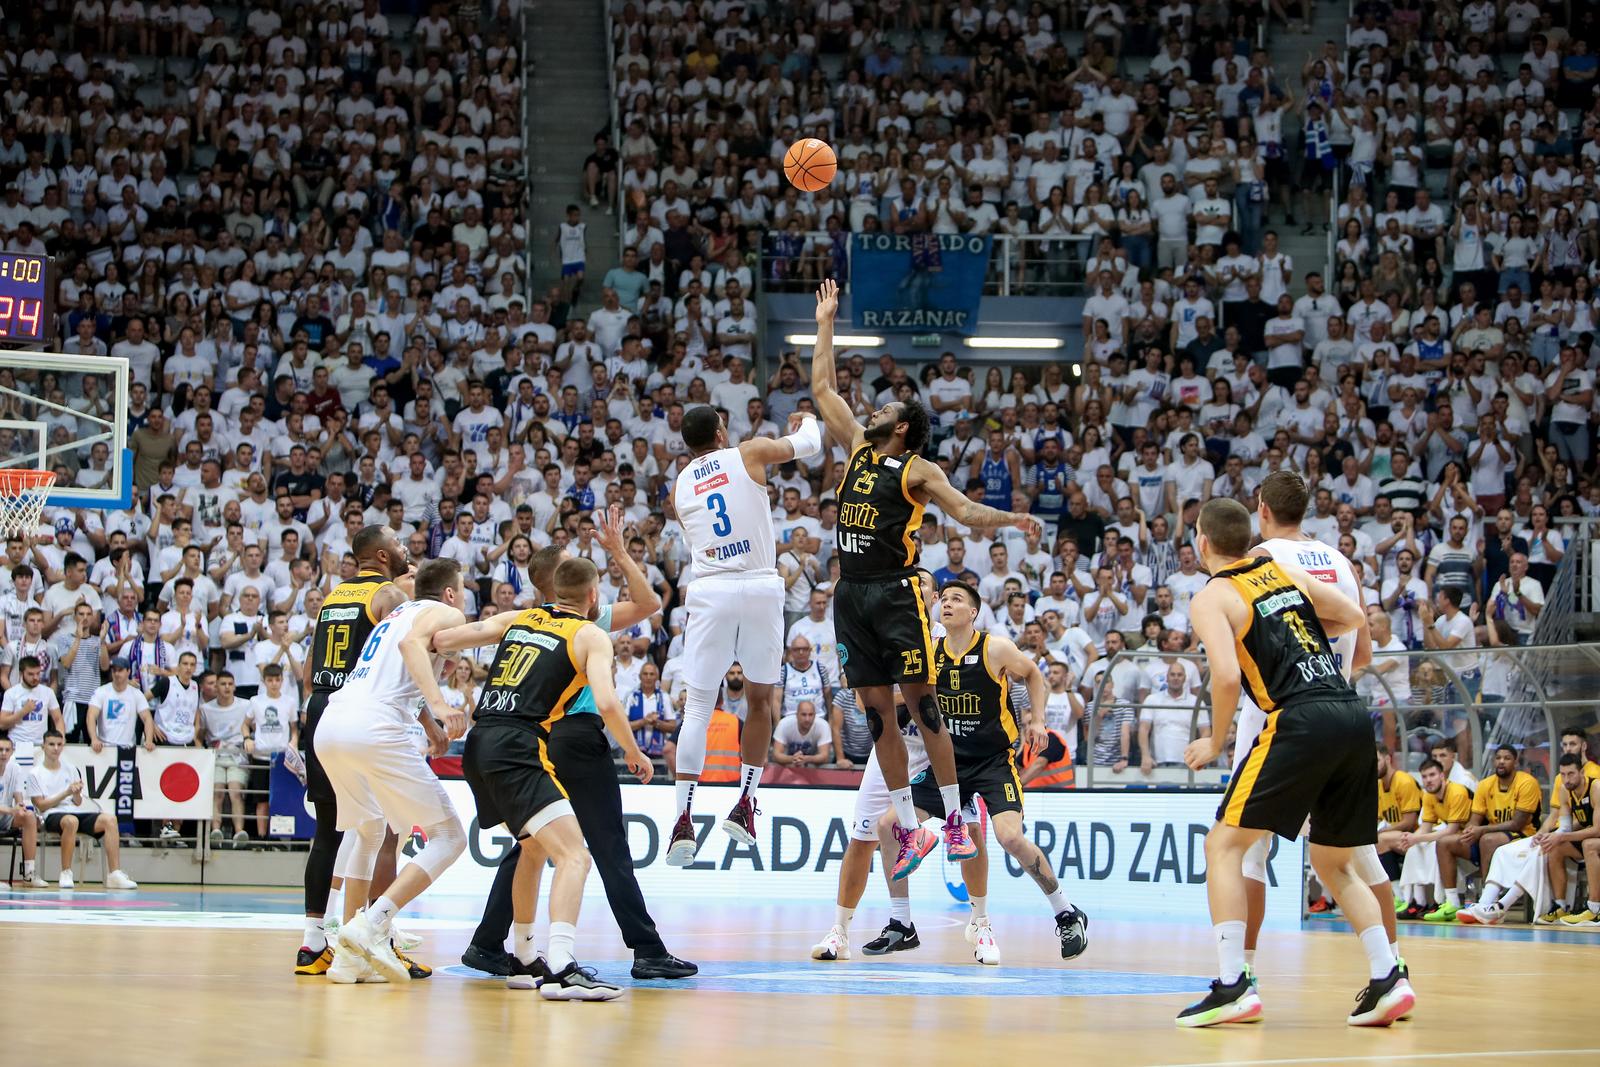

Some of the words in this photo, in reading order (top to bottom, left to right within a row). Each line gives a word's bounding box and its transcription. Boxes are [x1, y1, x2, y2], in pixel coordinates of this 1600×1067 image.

[694, 460, 721, 480] DAVIS
[698, 477, 725, 492] PETROL
[853, 470, 878, 495] 25
[706, 492, 732, 538] 3
[840, 502, 879, 530] split
[716, 539, 751, 560] ZADAR
[1297, 551, 1332, 566] BOŽIĆ
[323, 624, 351, 669] 12
[491, 643, 541, 687] 30
[901, 648, 922, 675] 25
[950, 669, 960, 690] 8
[480, 690, 521, 711] BOBIS
[792, 689, 820, 697] ZADAR
[937, 692, 981, 716] split
[117, 760, 134, 815] DRUGI
[1003, 783, 1016, 801] 8
